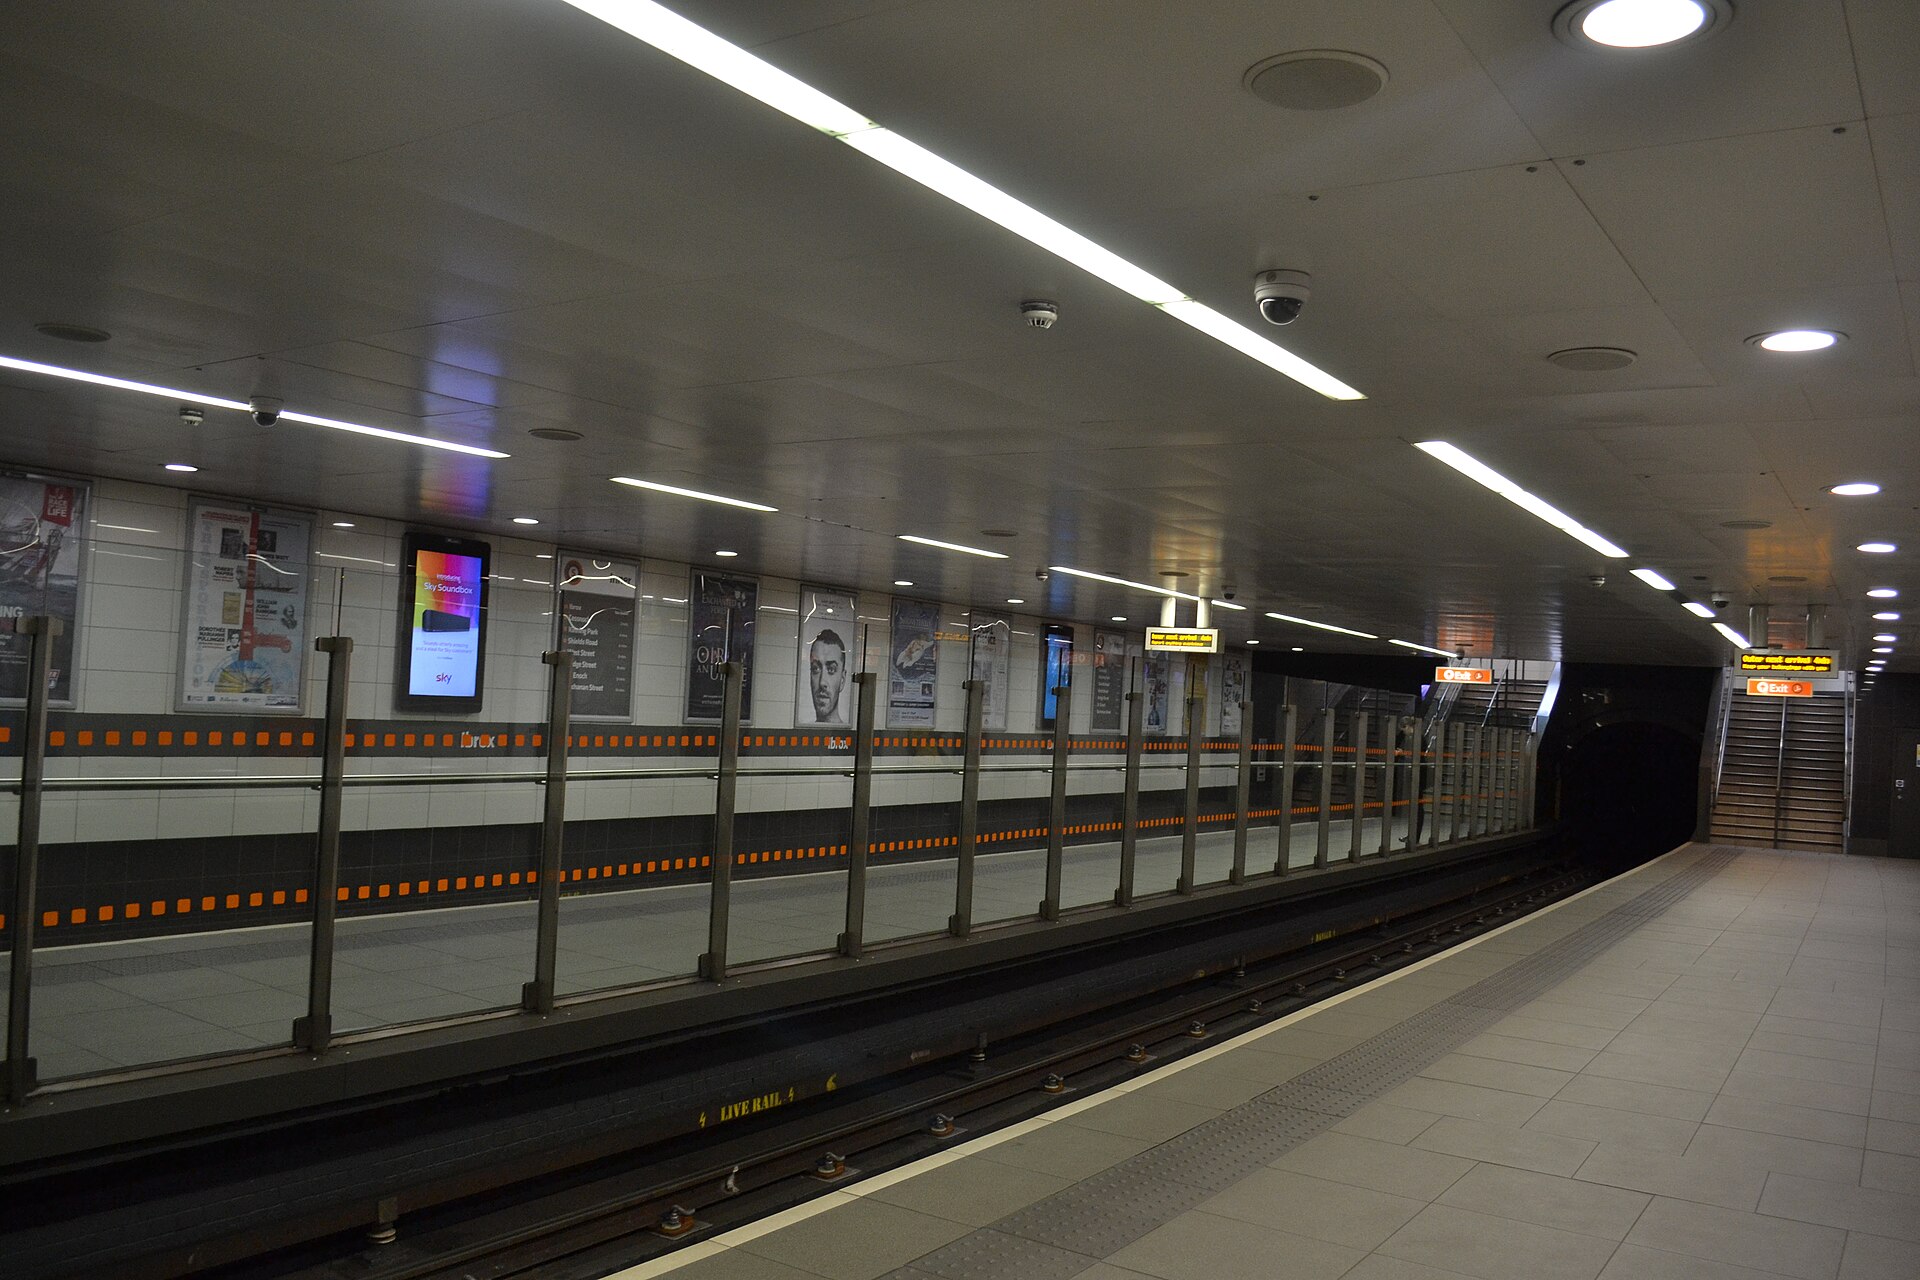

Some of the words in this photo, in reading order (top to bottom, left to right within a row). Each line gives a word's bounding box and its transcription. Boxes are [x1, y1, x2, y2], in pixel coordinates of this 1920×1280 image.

[47, 507, 68, 518] LIFE
[424, 582, 437, 592] Sky
[438, 583, 473, 594] Soundbox
[582, 660, 597, 668] Street
[436, 672, 452, 685] sky
[573, 672, 588, 680] Enoch
[1454, 671, 1471, 680] Exit
[1769, 684, 1788, 692] Exit
[720, 1100, 750, 1121] LIVE
[752, 1092, 782, 1112] RAIL
